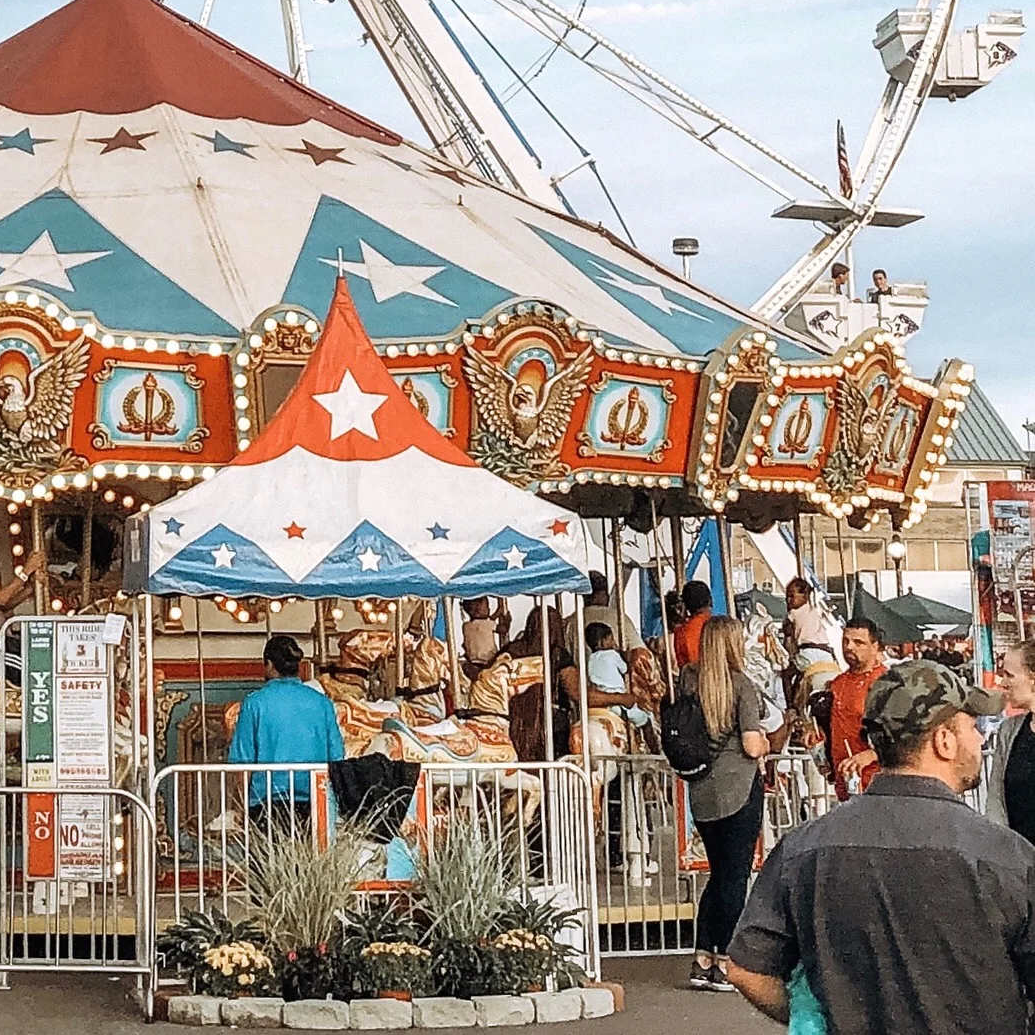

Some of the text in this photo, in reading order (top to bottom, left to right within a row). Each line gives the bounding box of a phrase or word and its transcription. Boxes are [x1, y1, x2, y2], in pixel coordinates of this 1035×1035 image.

[895, 323, 901, 332] 7
[61, 625, 80, 633] THIS
[69, 633, 97, 642] TAKES
[76, 644, 86, 657] 3
[60, 680, 102, 690] SAFETY
[30, 671, 51, 723] YES
[34, 811, 51, 841] NO
[60, 824, 79, 847] NO
